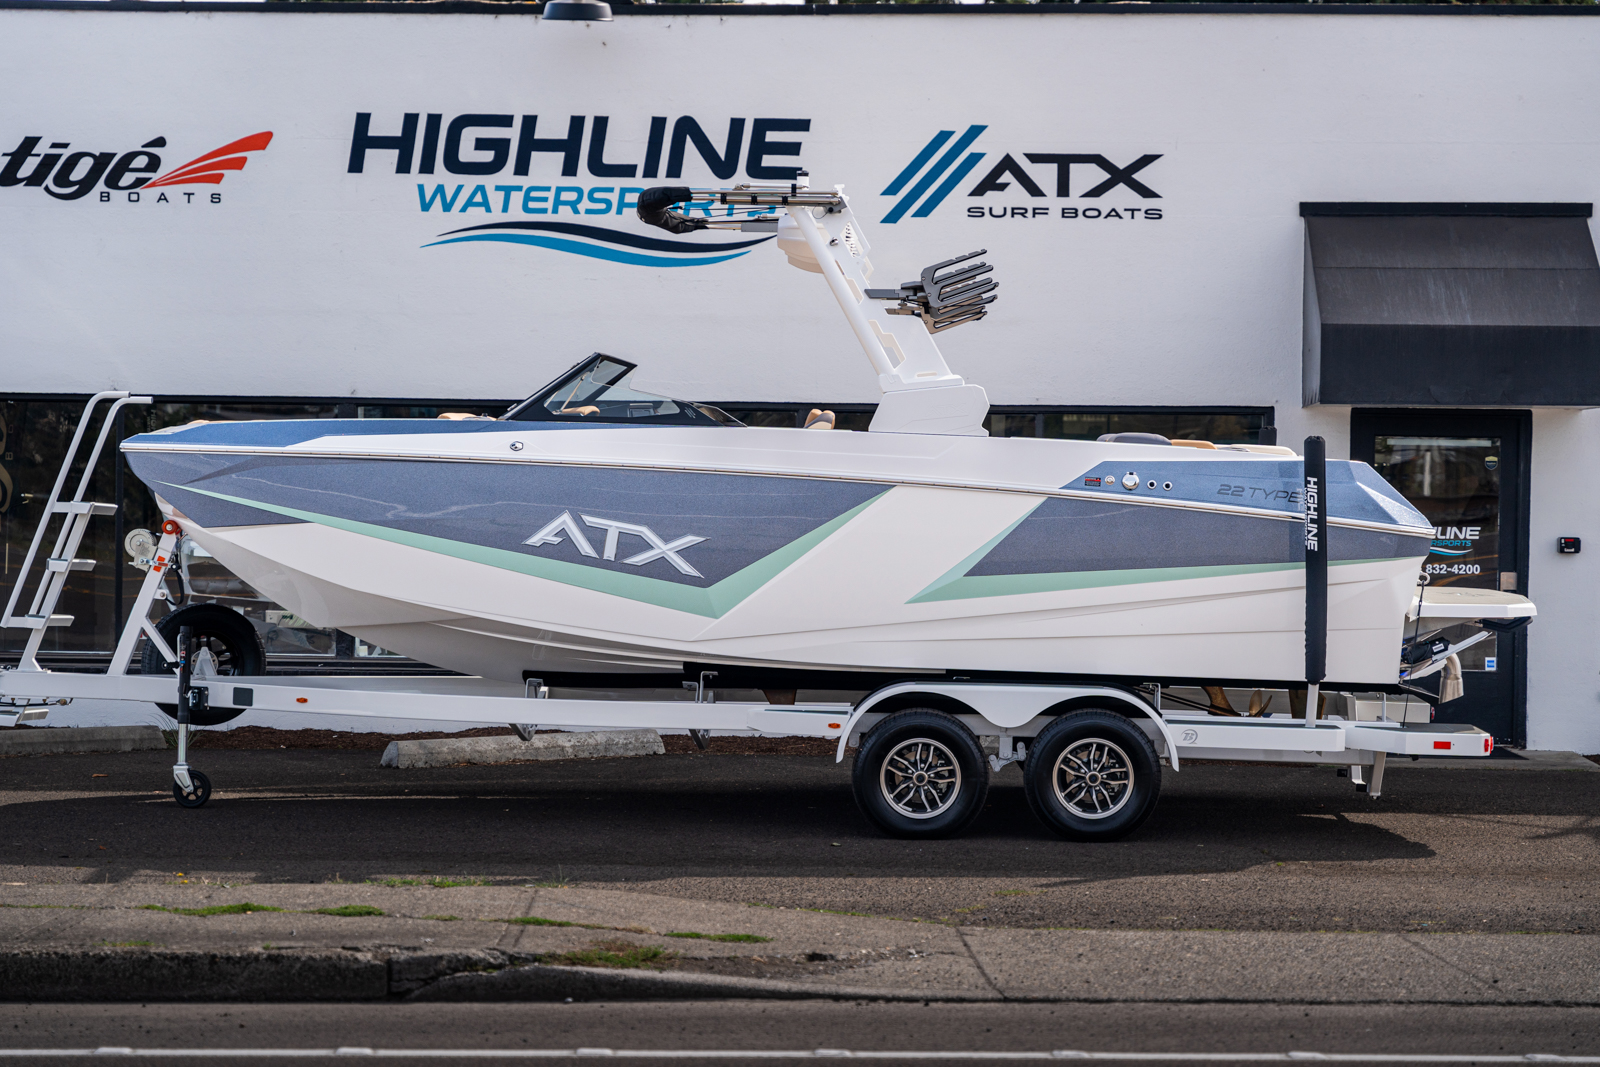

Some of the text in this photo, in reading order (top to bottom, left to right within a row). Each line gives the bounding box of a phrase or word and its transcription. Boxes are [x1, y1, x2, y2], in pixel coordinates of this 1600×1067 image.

[347, 111, 812, 180] HIGHLINE
[0, 136, 167, 201] tigé
[967, 152, 1165, 199] ATX
[100, 191, 221, 204] BOATS
[967, 207, 1164, 220] SURF BOATS
[1217, 484, 1245, 497] 22
[1307, 477, 1318, 552] HIGHLINE
[521, 509, 712, 580] ATX
[1435, 526, 1482, 540] LINE
[1425, 563, 1481, 575] 832-4200
